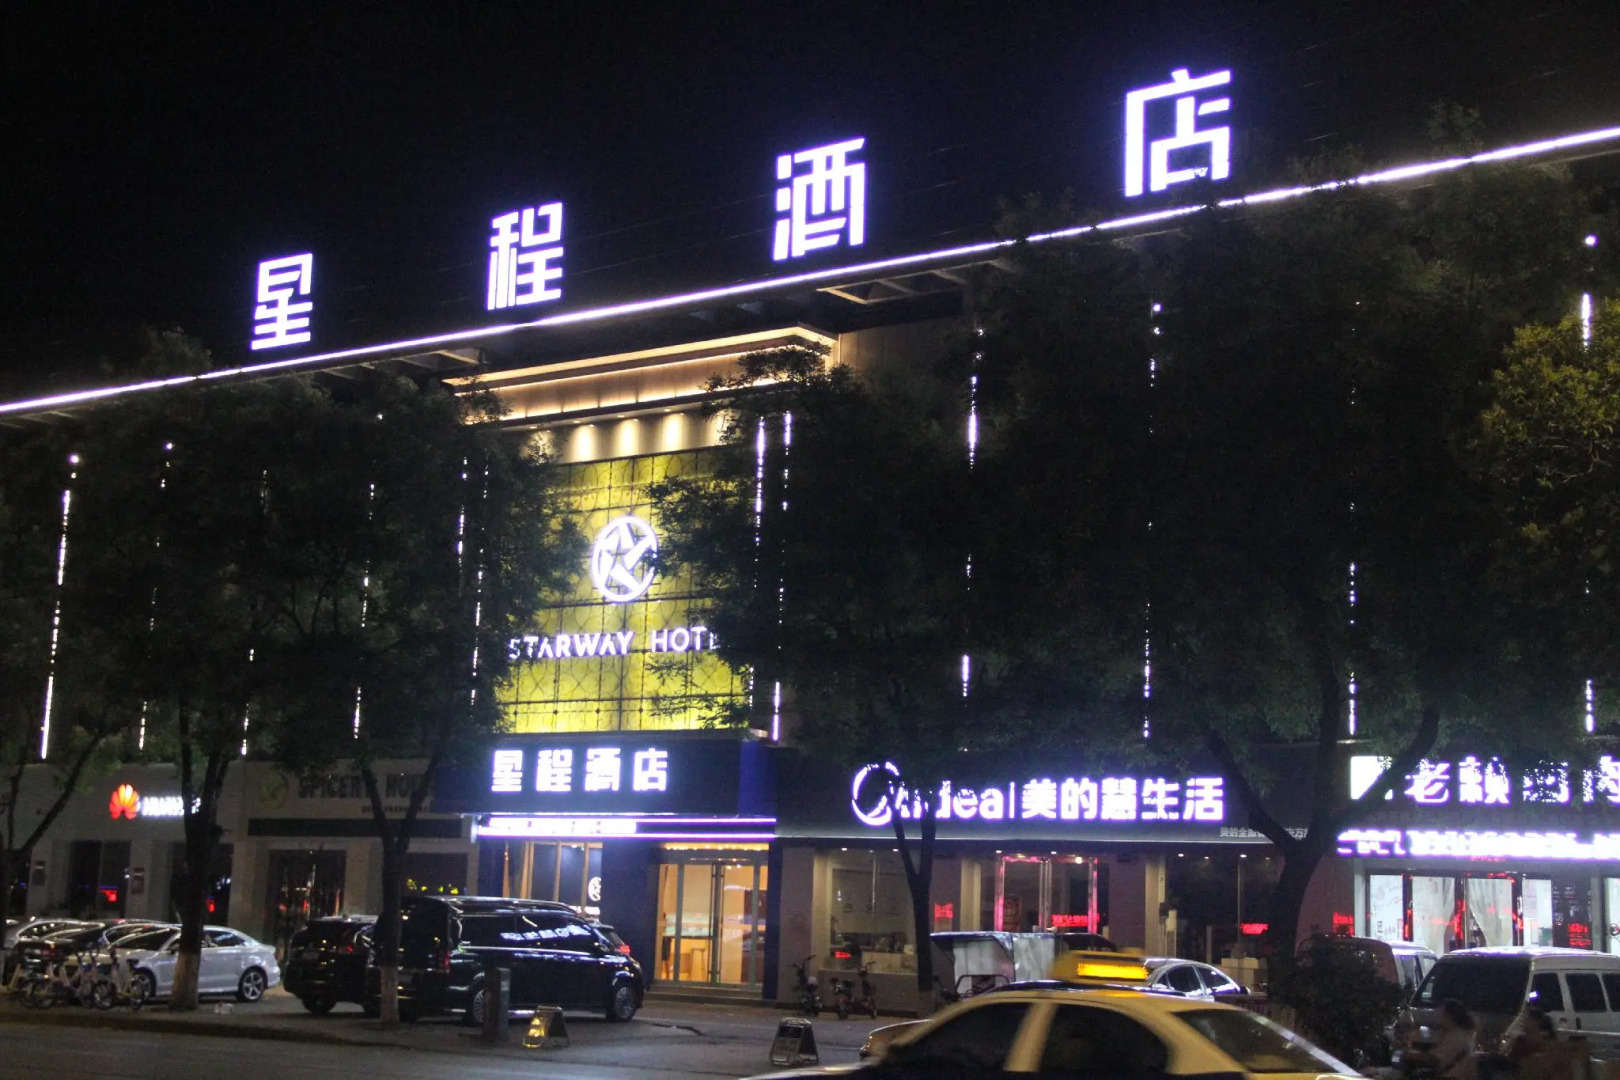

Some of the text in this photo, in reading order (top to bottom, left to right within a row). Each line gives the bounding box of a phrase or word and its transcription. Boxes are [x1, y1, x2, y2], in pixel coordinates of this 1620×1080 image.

[251, 68, 1232, 351] 星程酒店
[508, 630, 634, 660] STARWAY
[491, 747, 669, 793] 星程酒店
[1021, 776, 1225, 821] 美的慧生活
